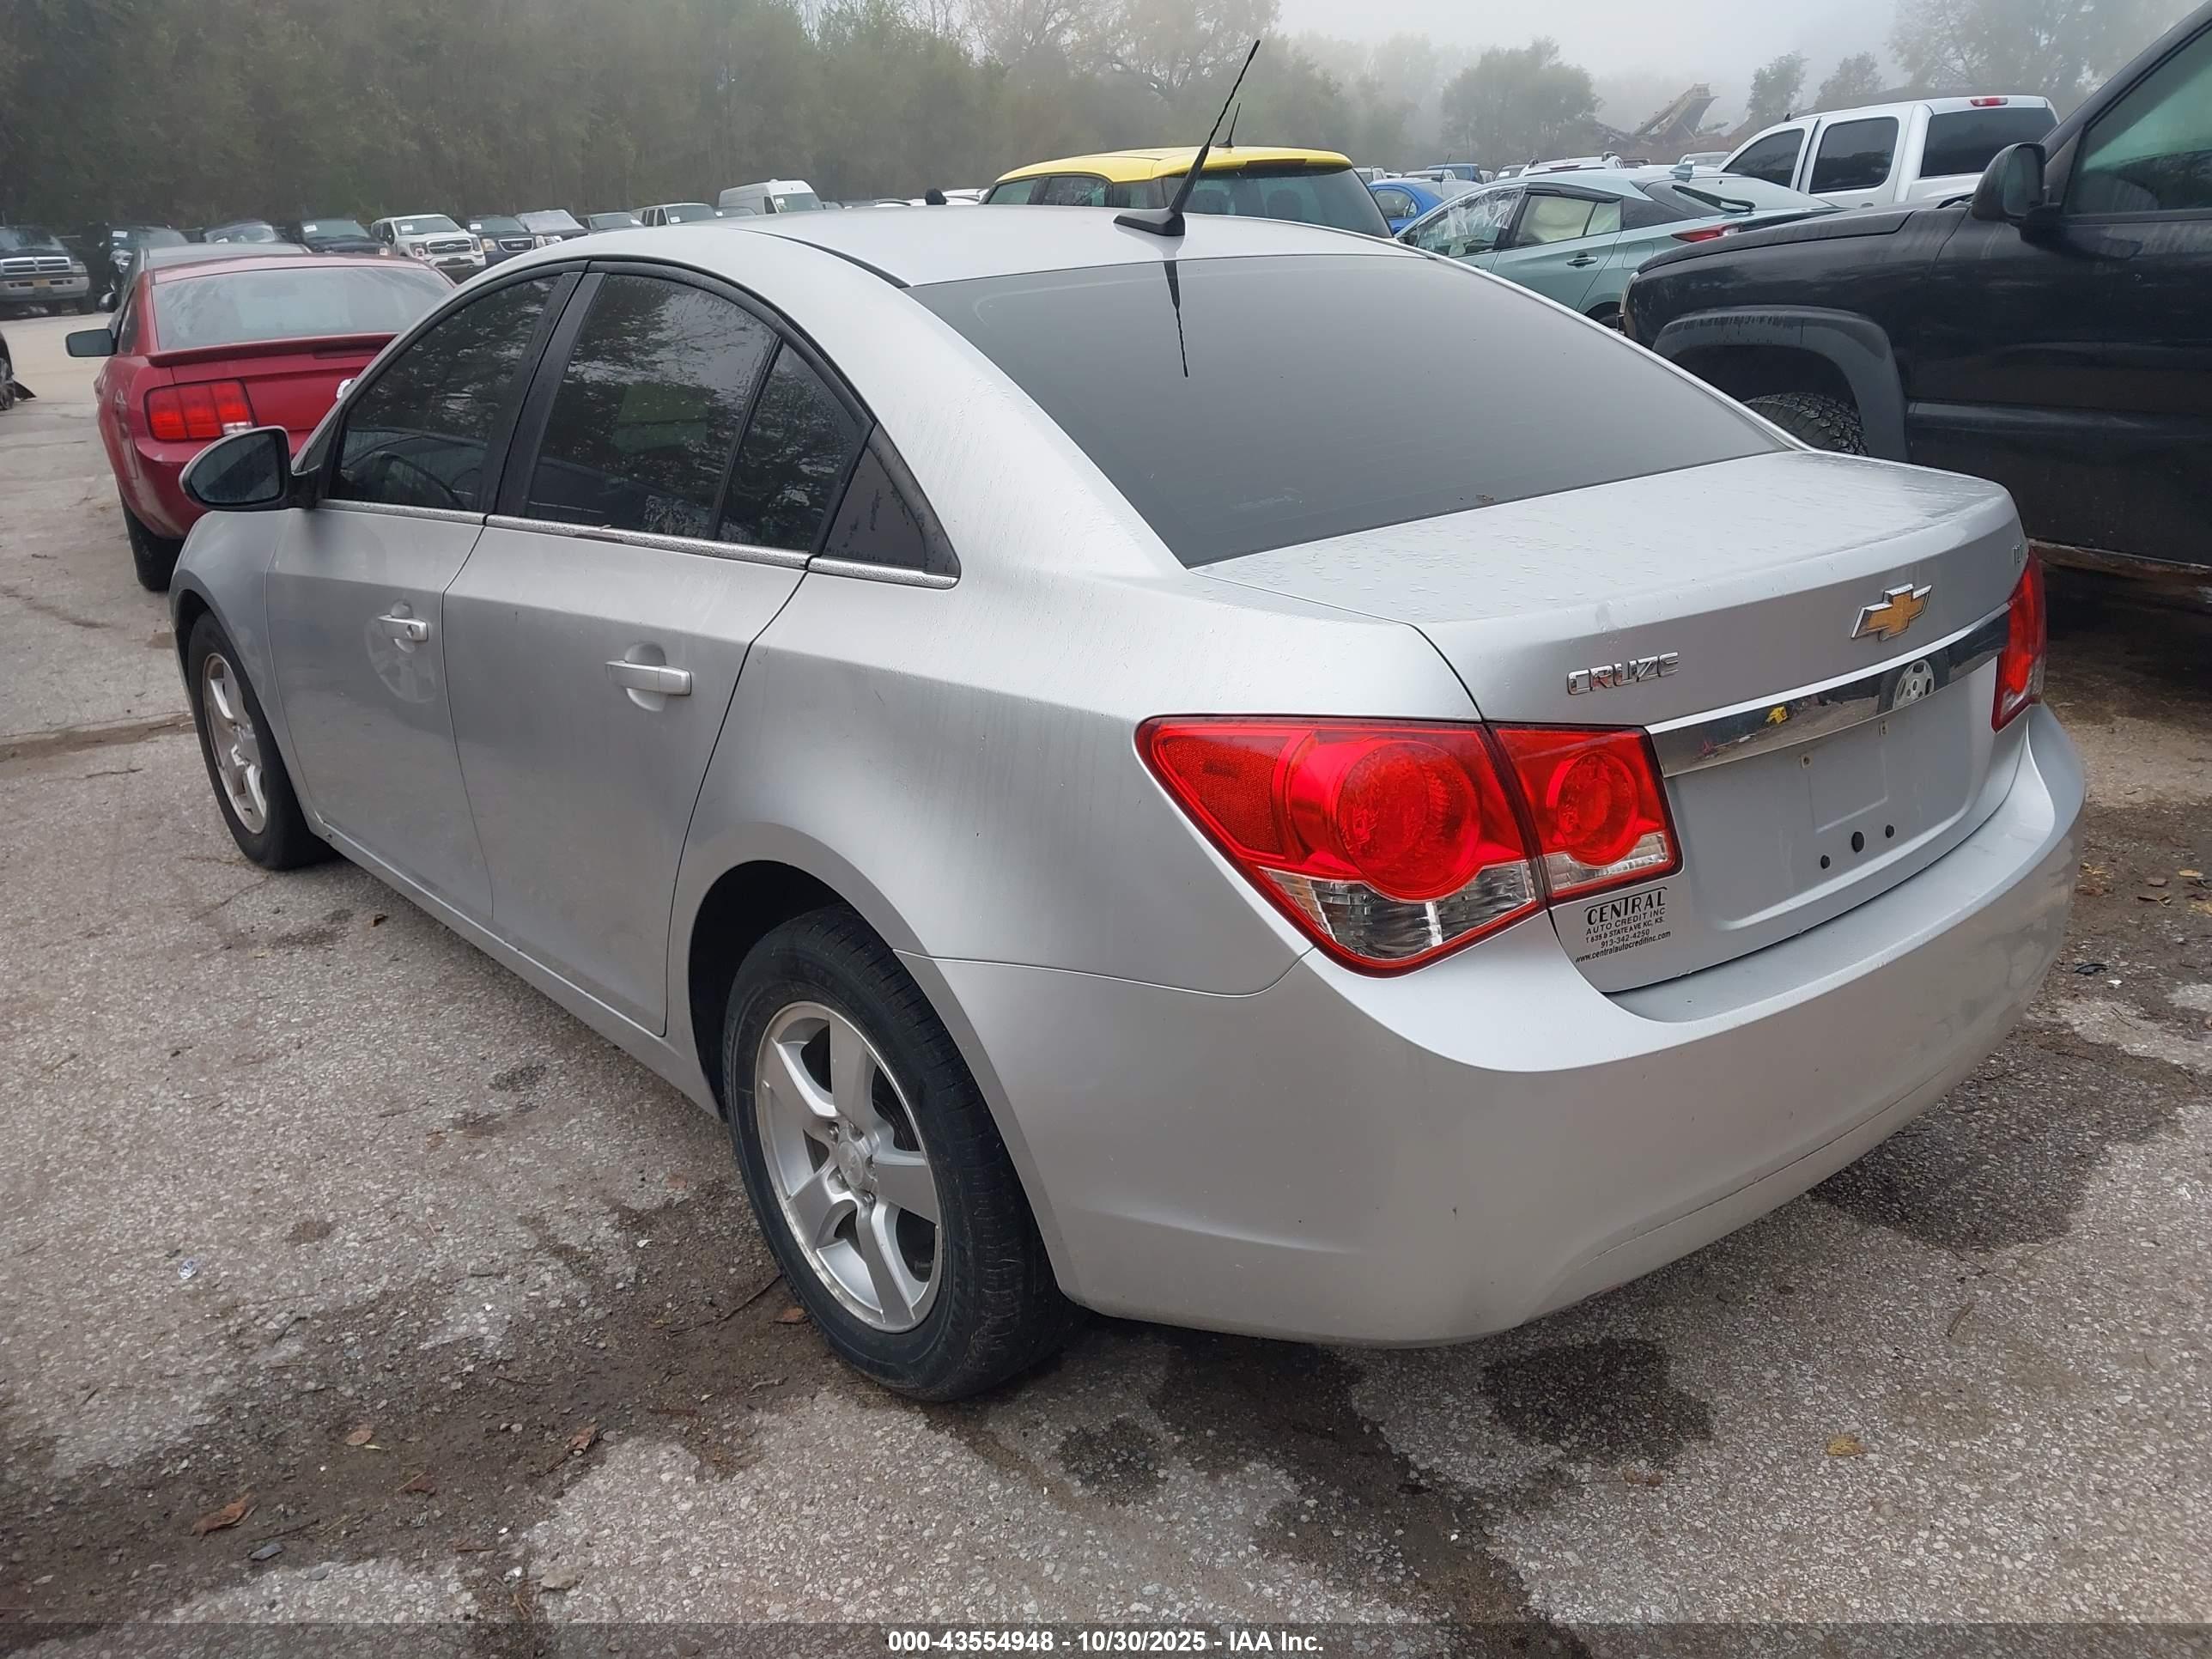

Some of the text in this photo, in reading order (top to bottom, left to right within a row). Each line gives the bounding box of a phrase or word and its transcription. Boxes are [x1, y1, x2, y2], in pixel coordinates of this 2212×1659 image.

[1567, 652, 1680, 695] CRUZE
[1584, 887, 1668, 926] CENTRAL
[1586, 908, 1666, 936] AUTO CREDIT INC
[1609, 926, 1628, 938] STATE
[1628, 922, 1642, 933] AVE
[1576, 931, 1672, 963] www.centralautocreditinc.com
[1601, 929, 1650, 949] 913-342-4250
